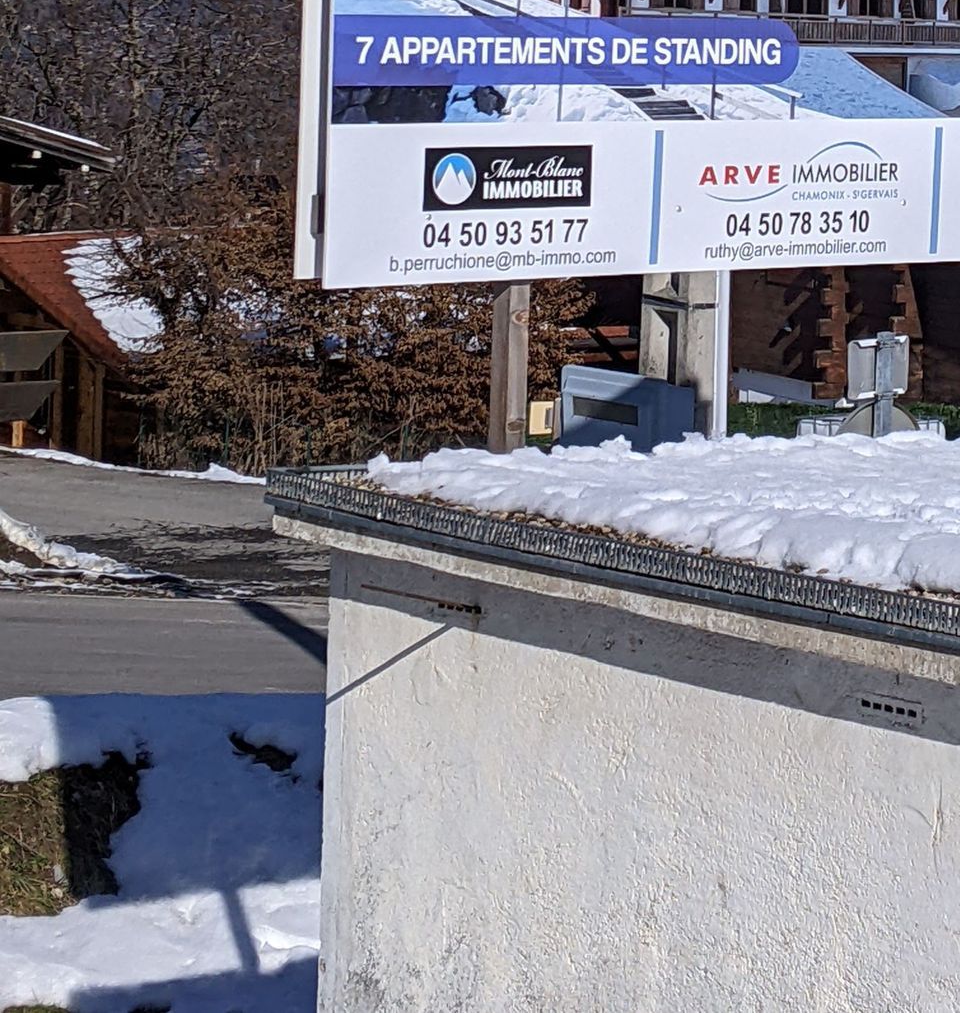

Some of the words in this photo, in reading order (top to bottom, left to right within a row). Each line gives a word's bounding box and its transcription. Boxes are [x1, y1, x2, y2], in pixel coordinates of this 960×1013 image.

[355, 36, 375, 65] 7
[380, 36, 605, 65] APPARTEMENTS
[611, 37, 648, 65] DE
[653, 37, 782, 65] STANDING
[483, 155, 584, 180] Mont-Blanc
[699, 165, 781, 186] ARVE
[792, 162, 899, 184] IMMOBILIER
[482, 179, 583, 200] IMMOBILIER
[791, 190, 845, 201] CHAMONIX
[423, 222, 451, 248] 04
[459, 222, 487, 247] 50
[495, 220, 522, 245] 93
[530, 219, 554, 244] 51
[562, 218, 589, 243] 77
[726, 213, 751, 237] 04
[758, 212, 783, 236] 50
[790, 211, 812, 235] 78
[819, 210, 843, 234] 35
[849, 210, 870, 233] 10
[389, 249, 617, 275] b.perruchione@mb-immo.com
[704, 239, 887, 262] ruthy@arve-immobilier.com
